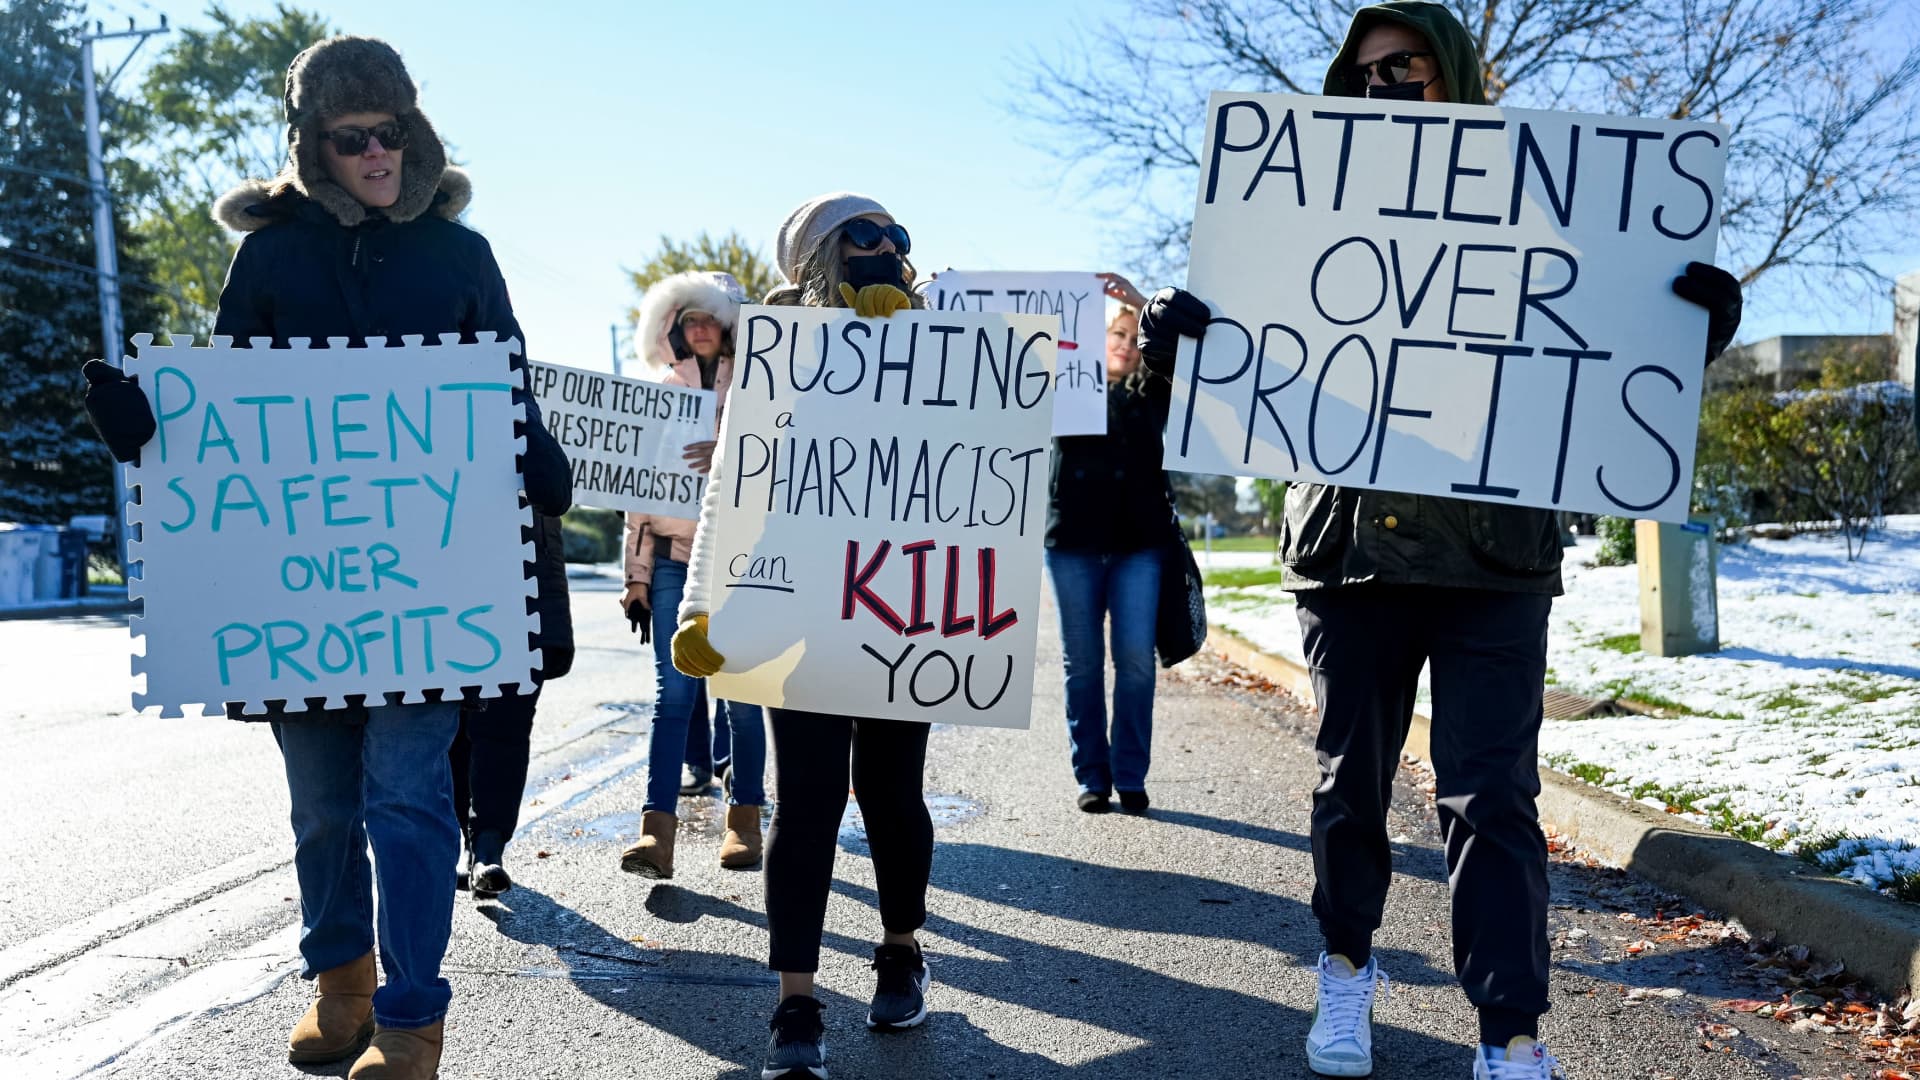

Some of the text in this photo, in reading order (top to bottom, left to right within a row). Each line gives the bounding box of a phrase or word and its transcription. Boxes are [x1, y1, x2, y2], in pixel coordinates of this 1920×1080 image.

[1205, 100, 1720, 241] PATIENTS
[1311, 236, 1590, 350] OVER
[528, 364, 558, 399] EP
[562, 371, 605, 408] OUR
[741, 315, 1052, 410] RUSHING
[155, 366, 512, 464] PATIENT
[548, 410, 644, 456] RESPECT
[775, 411, 796, 428] a
[1180, 317, 1684, 511] PROFITS
[161, 468, 461, 549] SAFETY
[735, 433, 1044, 536] PHARMACIST
[281, 543, 418, 592] OVER
[729, 539, 1019, 640] can KILL
[212, 605, 501, 686] PROFITS
[861, 642, 1013, 710] YOU
